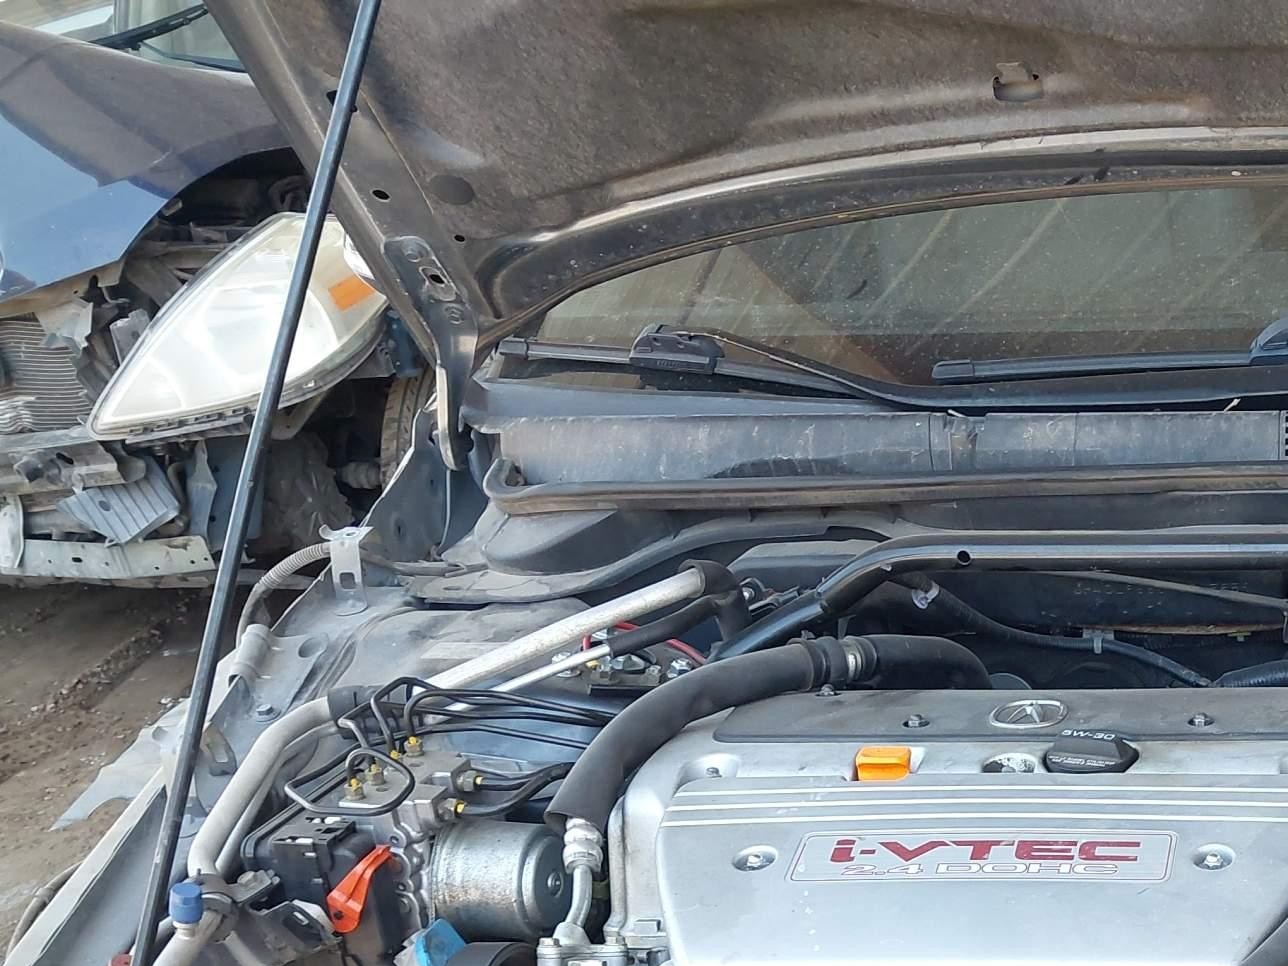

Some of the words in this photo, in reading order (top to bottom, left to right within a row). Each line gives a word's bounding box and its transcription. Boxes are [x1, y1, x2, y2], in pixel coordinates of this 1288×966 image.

[1062, 729, 1116, 740] 5W-30
[830, 839, 1141, 863] i-VTEC
[841, 863, 924, 876] 2.4
[935, 863, 1119, 875] DOHC
